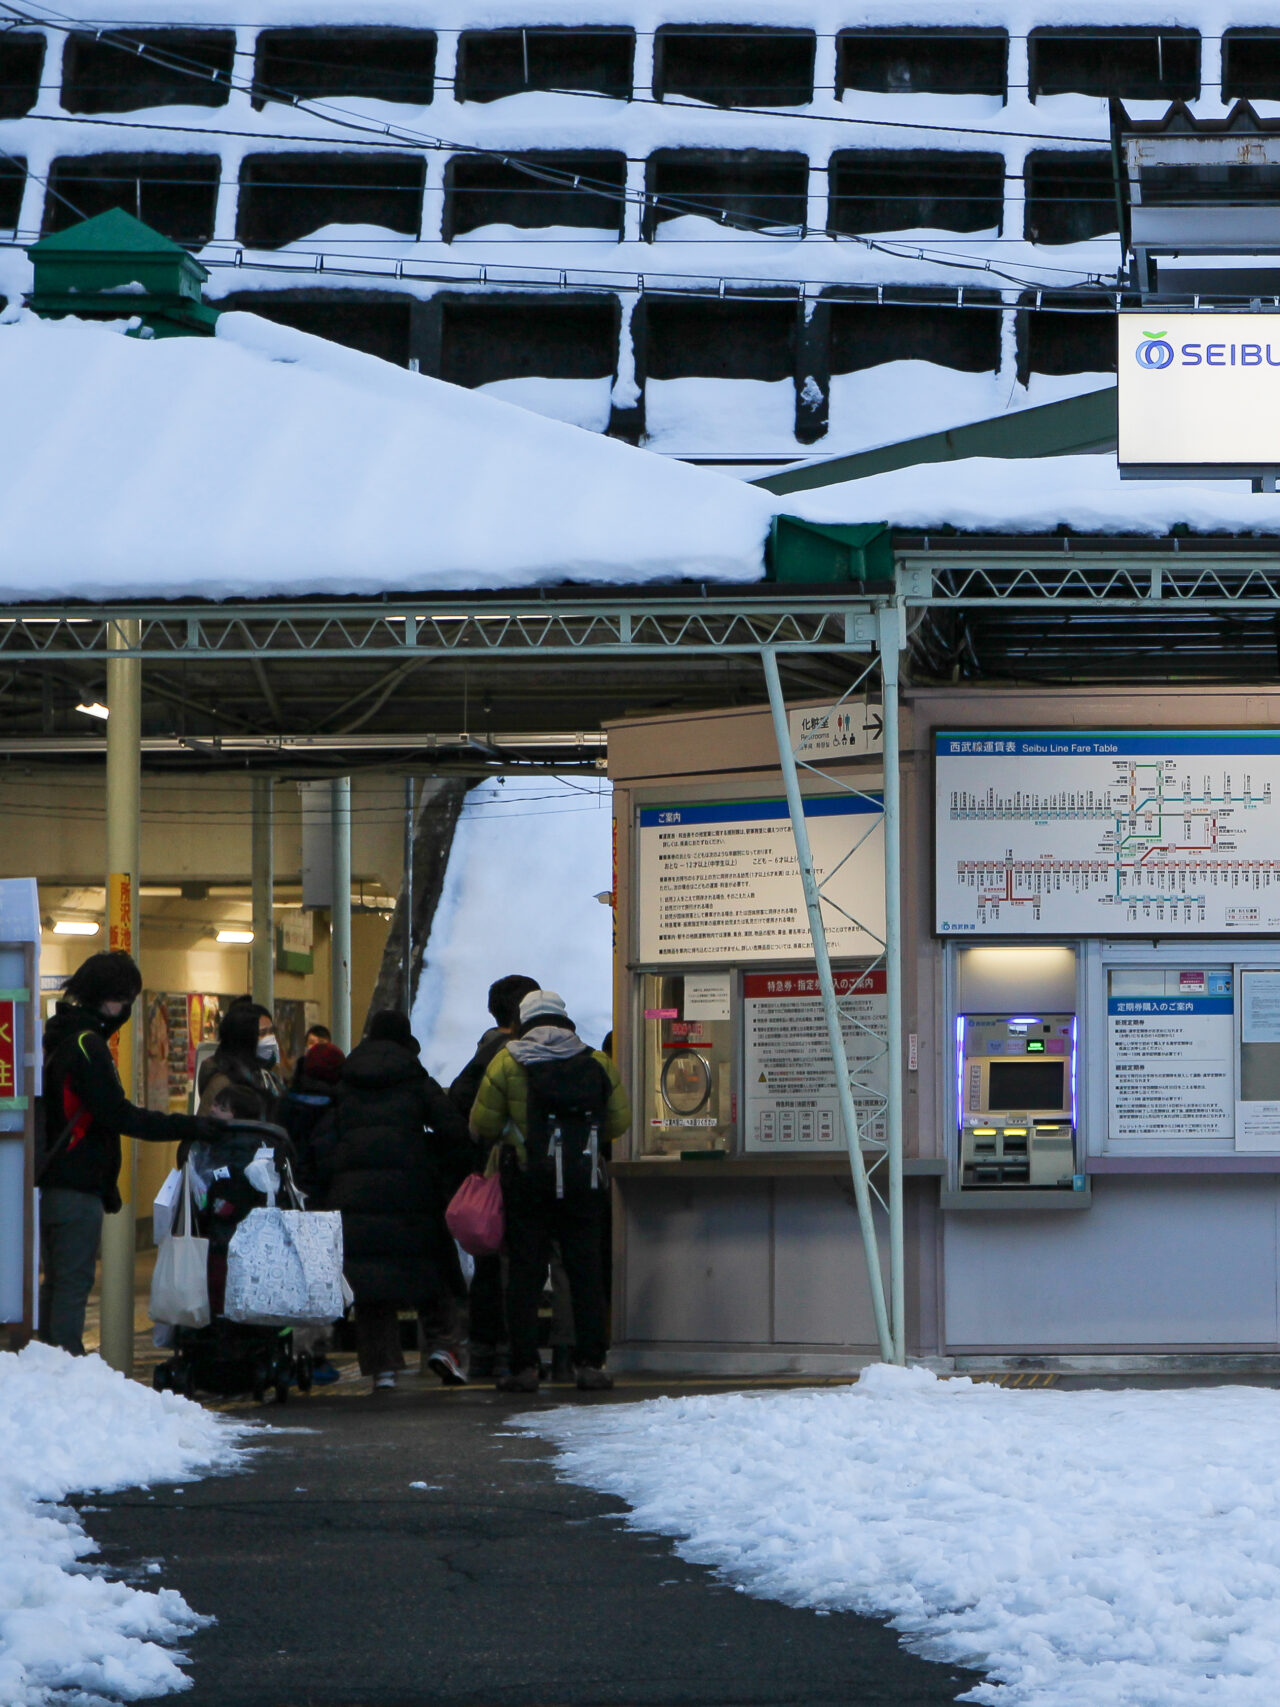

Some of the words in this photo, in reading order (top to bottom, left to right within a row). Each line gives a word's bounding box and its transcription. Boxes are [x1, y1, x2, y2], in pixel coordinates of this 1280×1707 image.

[802, 716, 829, 731] 化粧室
[949, 741, 1016, 752] 西武線運賃表
[1022, 744, 1048, 752] Seibu
[1050, 744, 1069, 752] Line
[1071, 744, 1091, 752] Fare
[1093, 744, 1118, 752] Table
[658, 813, 681, 823] ご案内
[767, 978, 873, 992] 特急券・指定券入のご案内
[1117, 1002, 1194, 1011] 定期券購入のご案内
